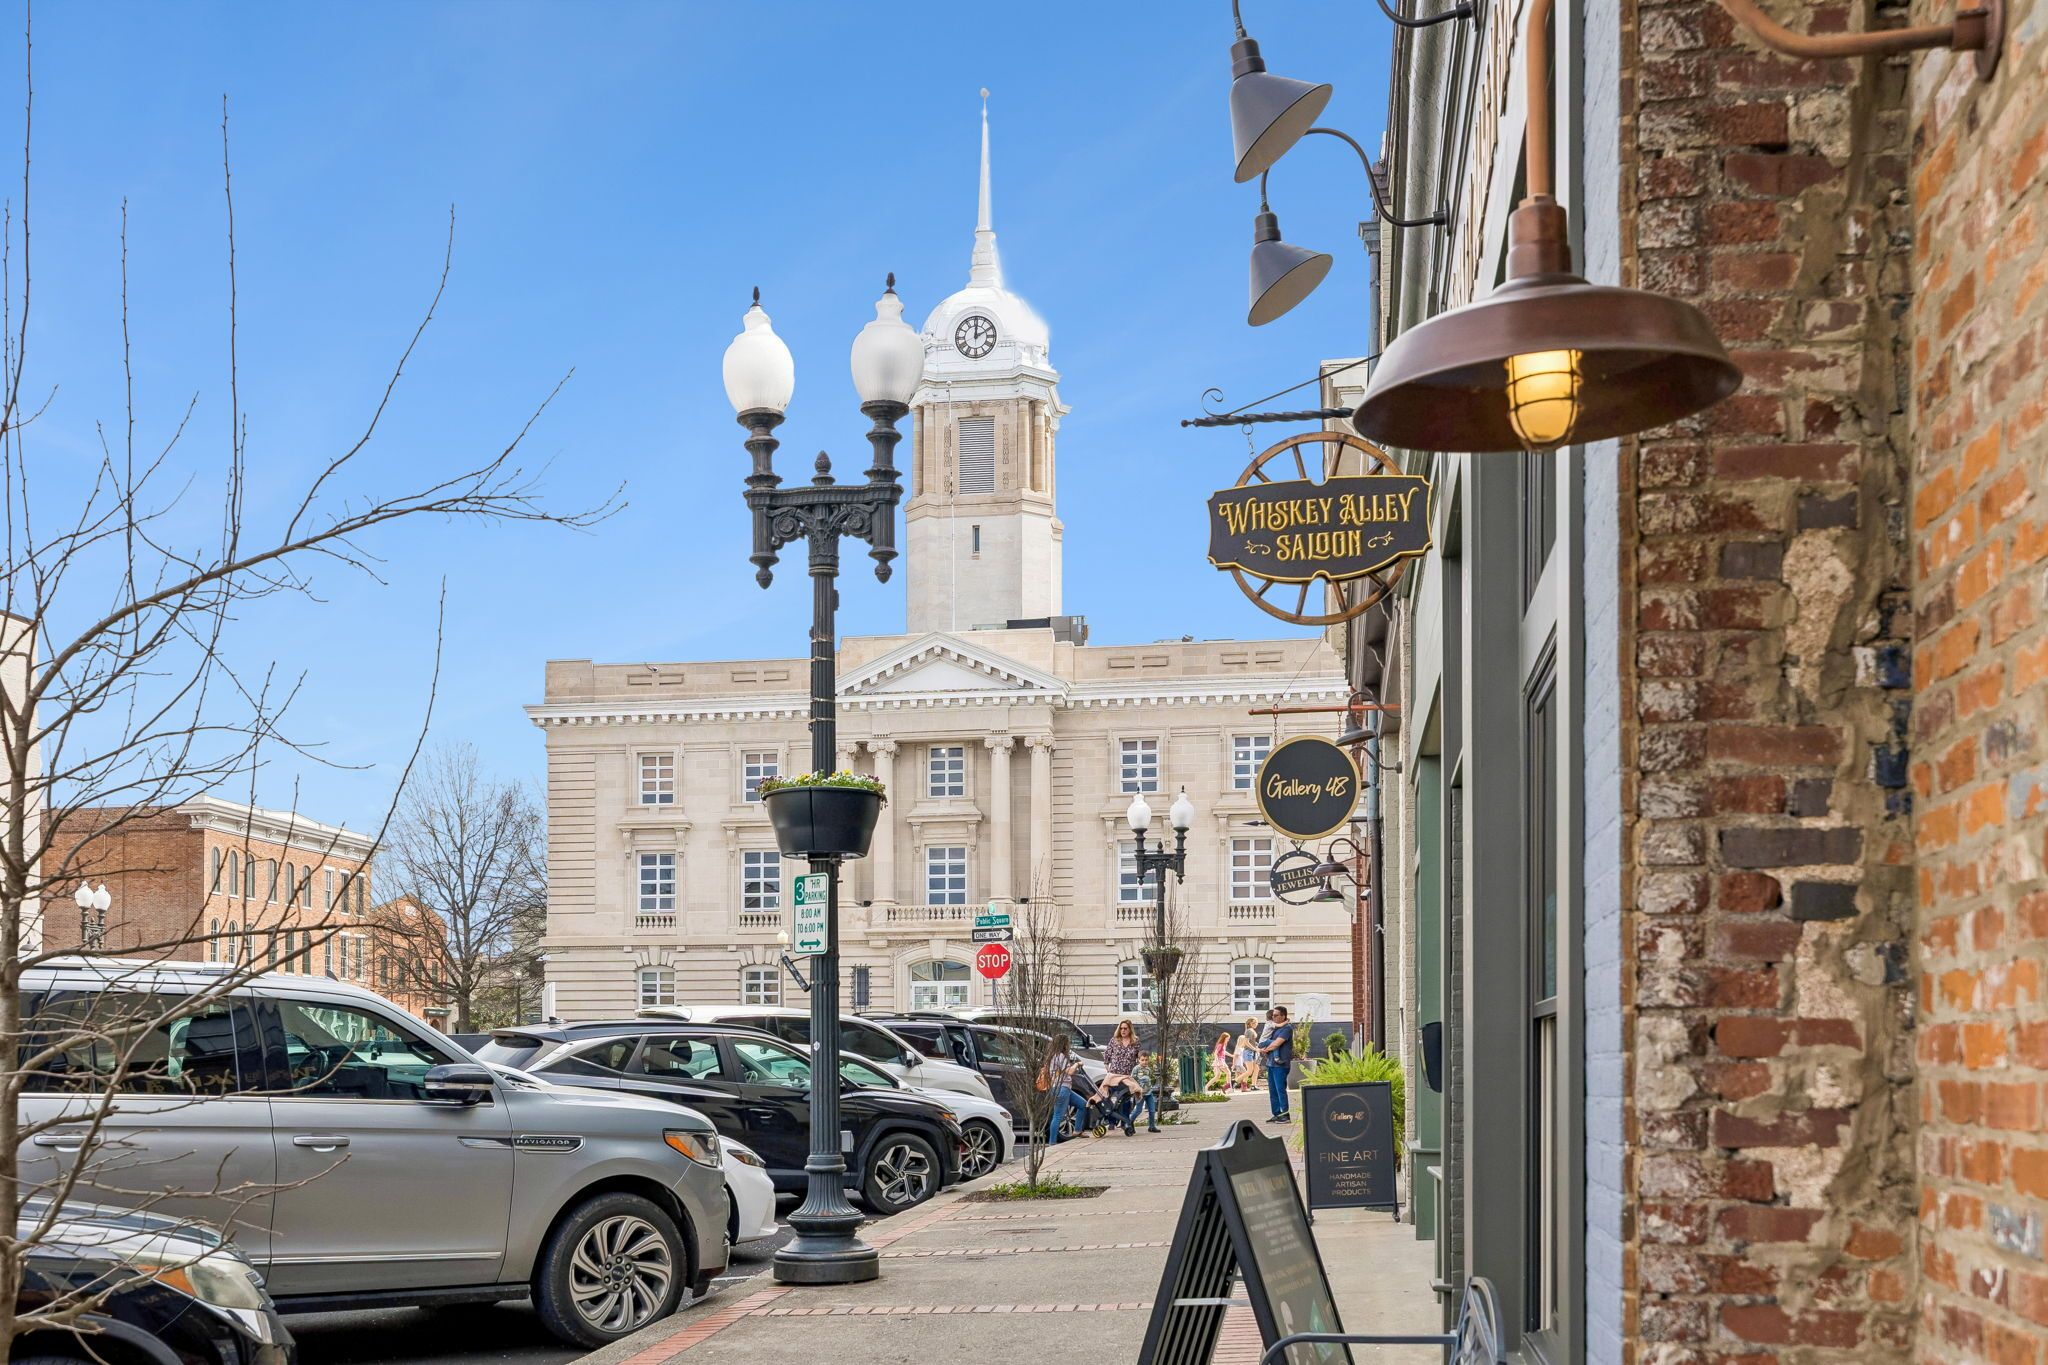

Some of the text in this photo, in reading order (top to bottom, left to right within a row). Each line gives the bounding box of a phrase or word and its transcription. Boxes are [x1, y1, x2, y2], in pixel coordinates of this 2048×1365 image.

[1218, 487, 1419, 536] WHISKEY ALLEY
[1276, 529, 1363, 561] SALOON
[1266, 773, 1350, 804] Gallery 48
[1281, 868, 1313, 882] TILLIS
[810, 878, 821, 889] HR
[1276, 876, 1322, 893] JEWELRY
[795, 882, 804, 901] 3
[805, 890, 826, 901] PARKING
[800, 908, 821, 919] 8:00 AM
[976, 916, 1009, 926] Public Square
[797, 922, 824, 933] TO 6:00 PM
[978, 954, 1009, 968] STOP
[1319, 1150, 1379, 1163] FINE ART
[1329, 1172, 1372, 1180] HANDMADE
[1335, 1180, 1367, 1188] ARTISAN
[1331, 1188, 1372, 1196] PRODUCTS
